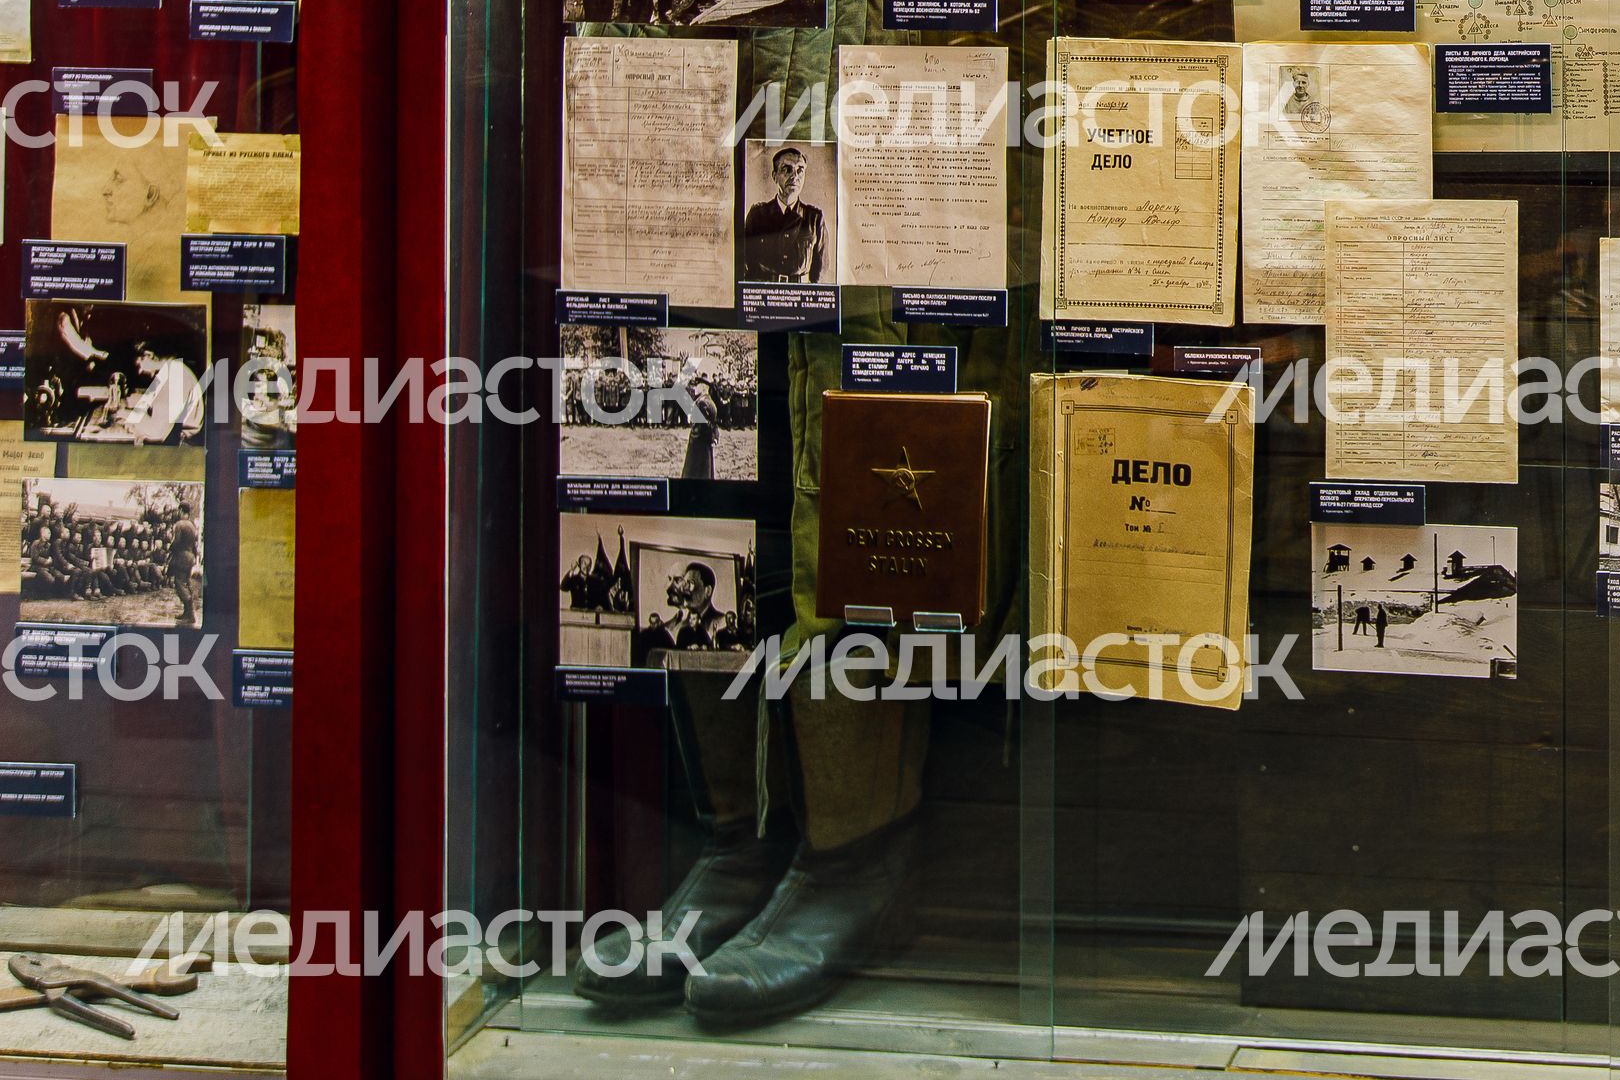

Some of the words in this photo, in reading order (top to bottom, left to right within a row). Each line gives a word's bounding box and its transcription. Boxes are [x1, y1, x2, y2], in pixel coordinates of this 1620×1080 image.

[1087, 128, 1154, 144] УЧЕТНОЕ
[1091, 154, 1132, 171] ДЕЛО
[1112, 459, 1192, 487] ДЕЛО
[848, 528, 879, 546] DEM
[887, 530, 954, 549] GROSSEN
[869, 555, 928, 574] STALIN
